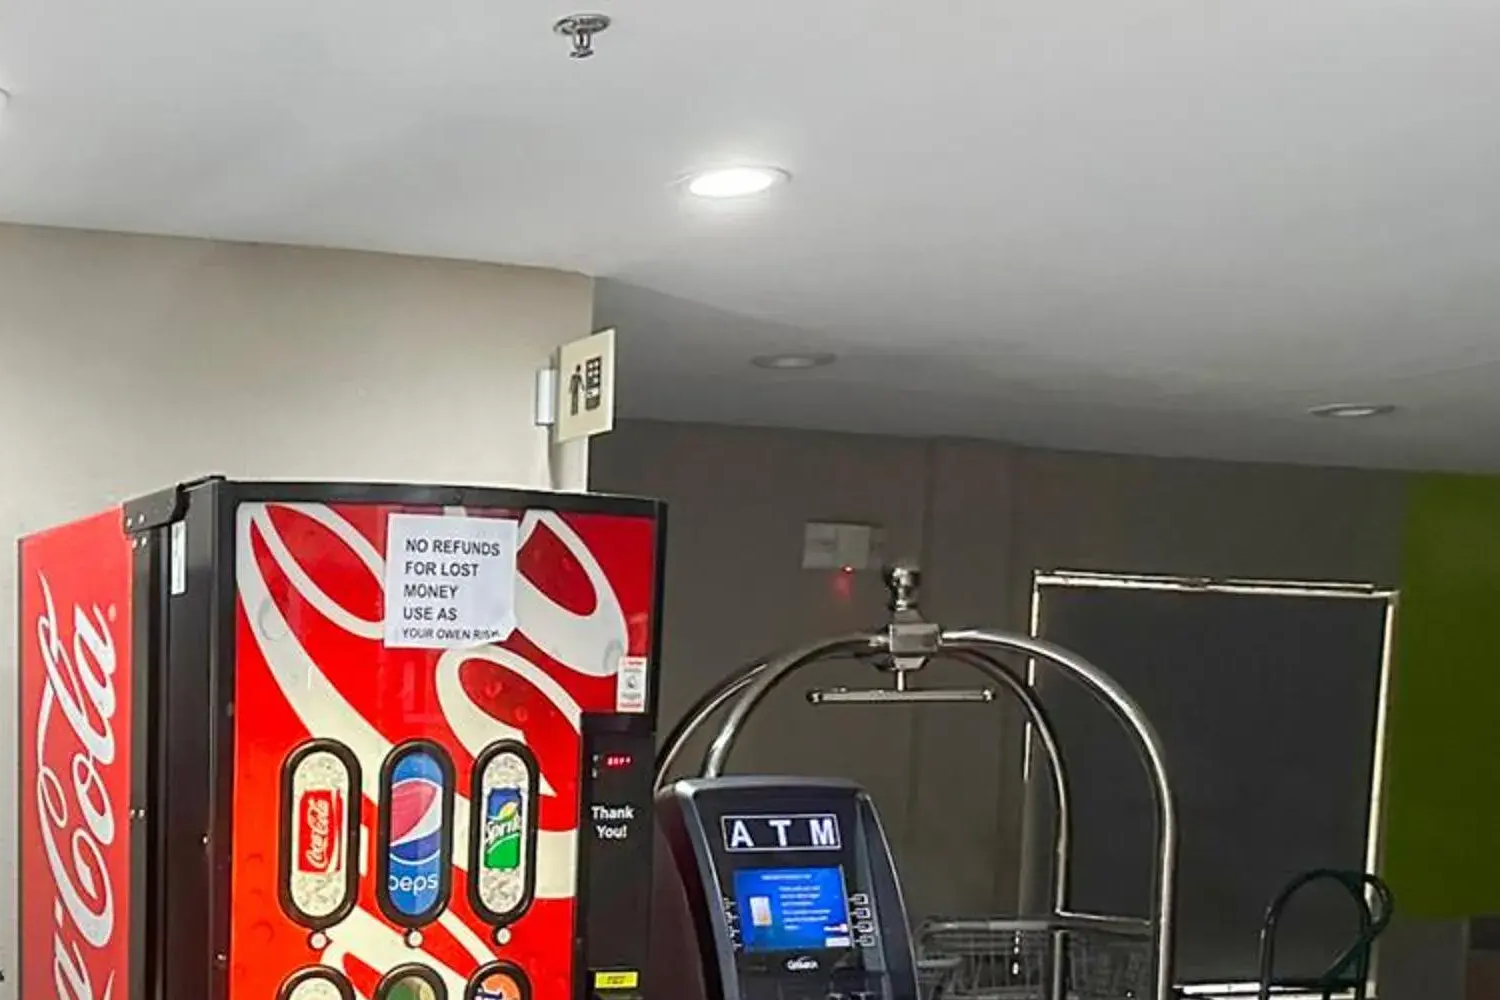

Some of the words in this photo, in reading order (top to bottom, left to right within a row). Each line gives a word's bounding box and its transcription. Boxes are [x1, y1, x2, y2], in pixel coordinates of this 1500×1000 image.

[405, 539, 429, 553] NO
[432, 539, 501, 557] REFUNDS
[404, 561, 437, 576] FOR
[441, 562, 479, 577] LOST
[403, 584, 458, 599] MONEY
[403, 607, 434, 621] USE
[437, 607, 458, 622] AS
[402, 628, 434, 640] YOUR
[436, 628, 471, 640] OWEN
[592, 805, 635, 821] Thank
[597, 825, 628, 840] You!
[730, 819, 835, 848] ATM
